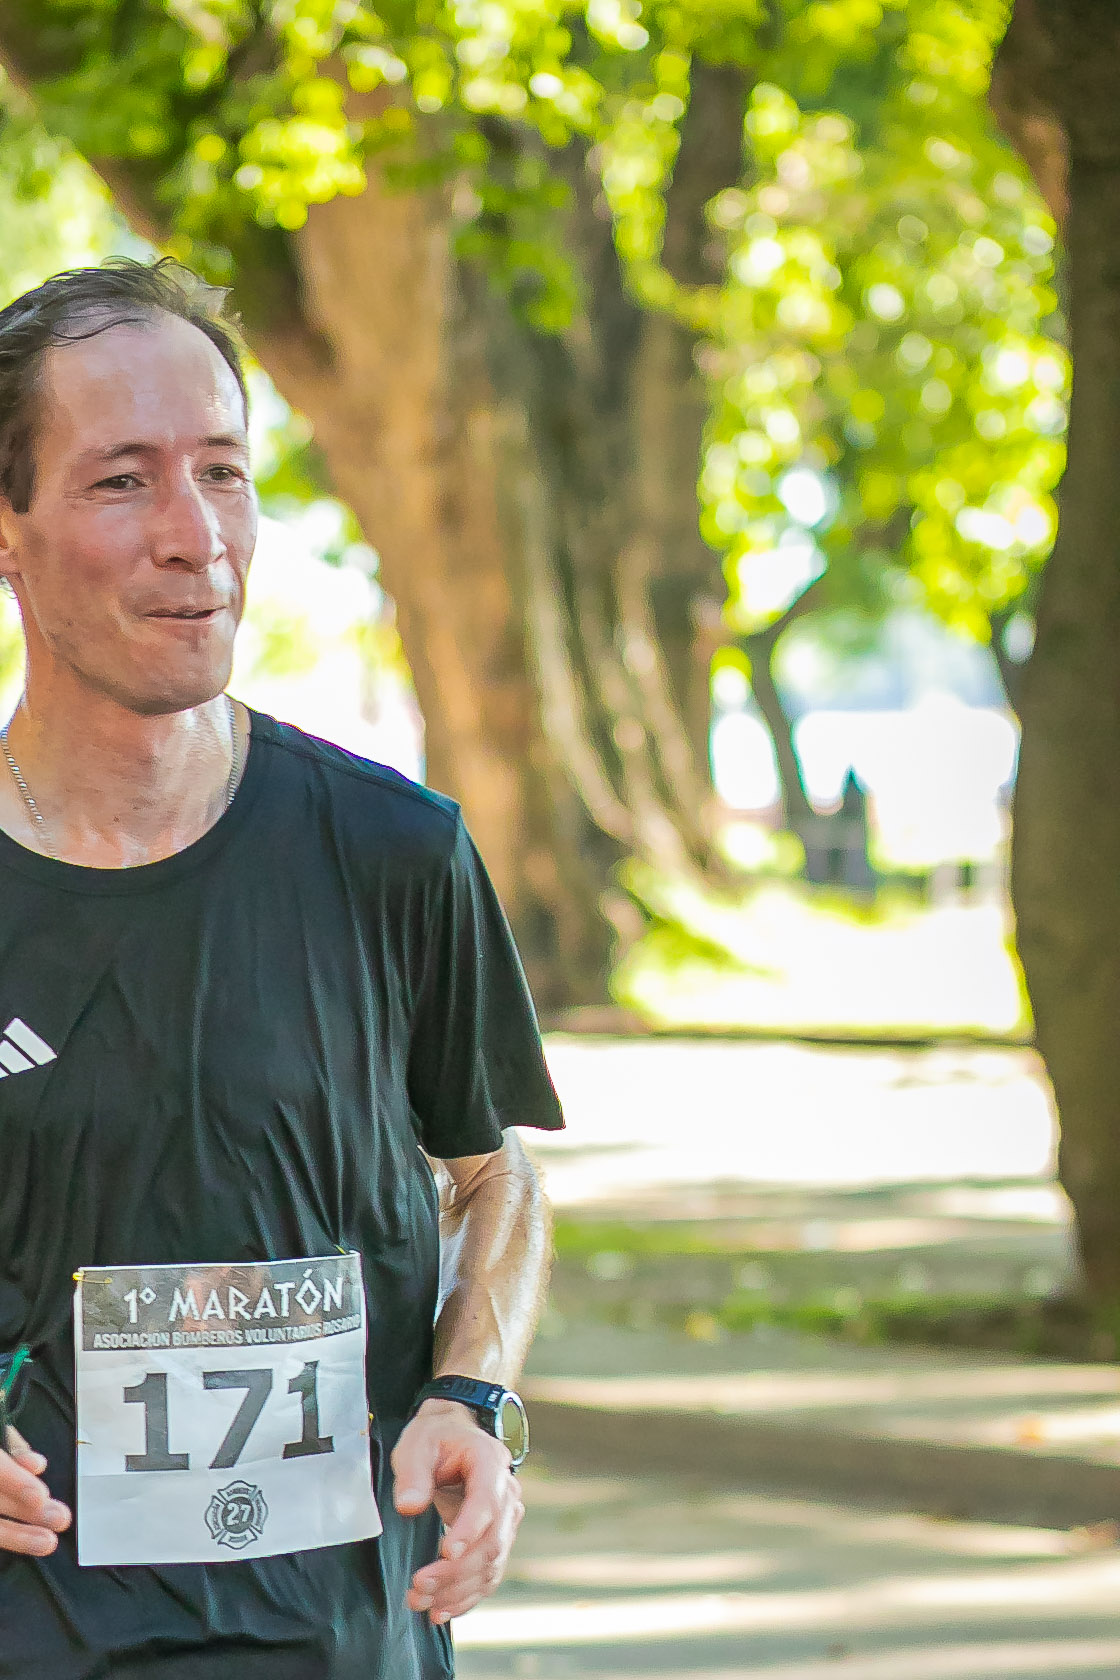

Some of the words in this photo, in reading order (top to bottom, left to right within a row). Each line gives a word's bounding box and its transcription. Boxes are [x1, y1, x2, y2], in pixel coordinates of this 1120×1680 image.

[168, 1268, 343, 1322] MARATÓN
[93, 1331, 171, 1348] ASOCIACION
[171, 1329, 244, 1346] BOMBEROS
[244, 1322, 322, 1344] VOLUNTARIOS
[123, 1360, 335, 1473] 171
[226, 1502, 252, 1526] 27
